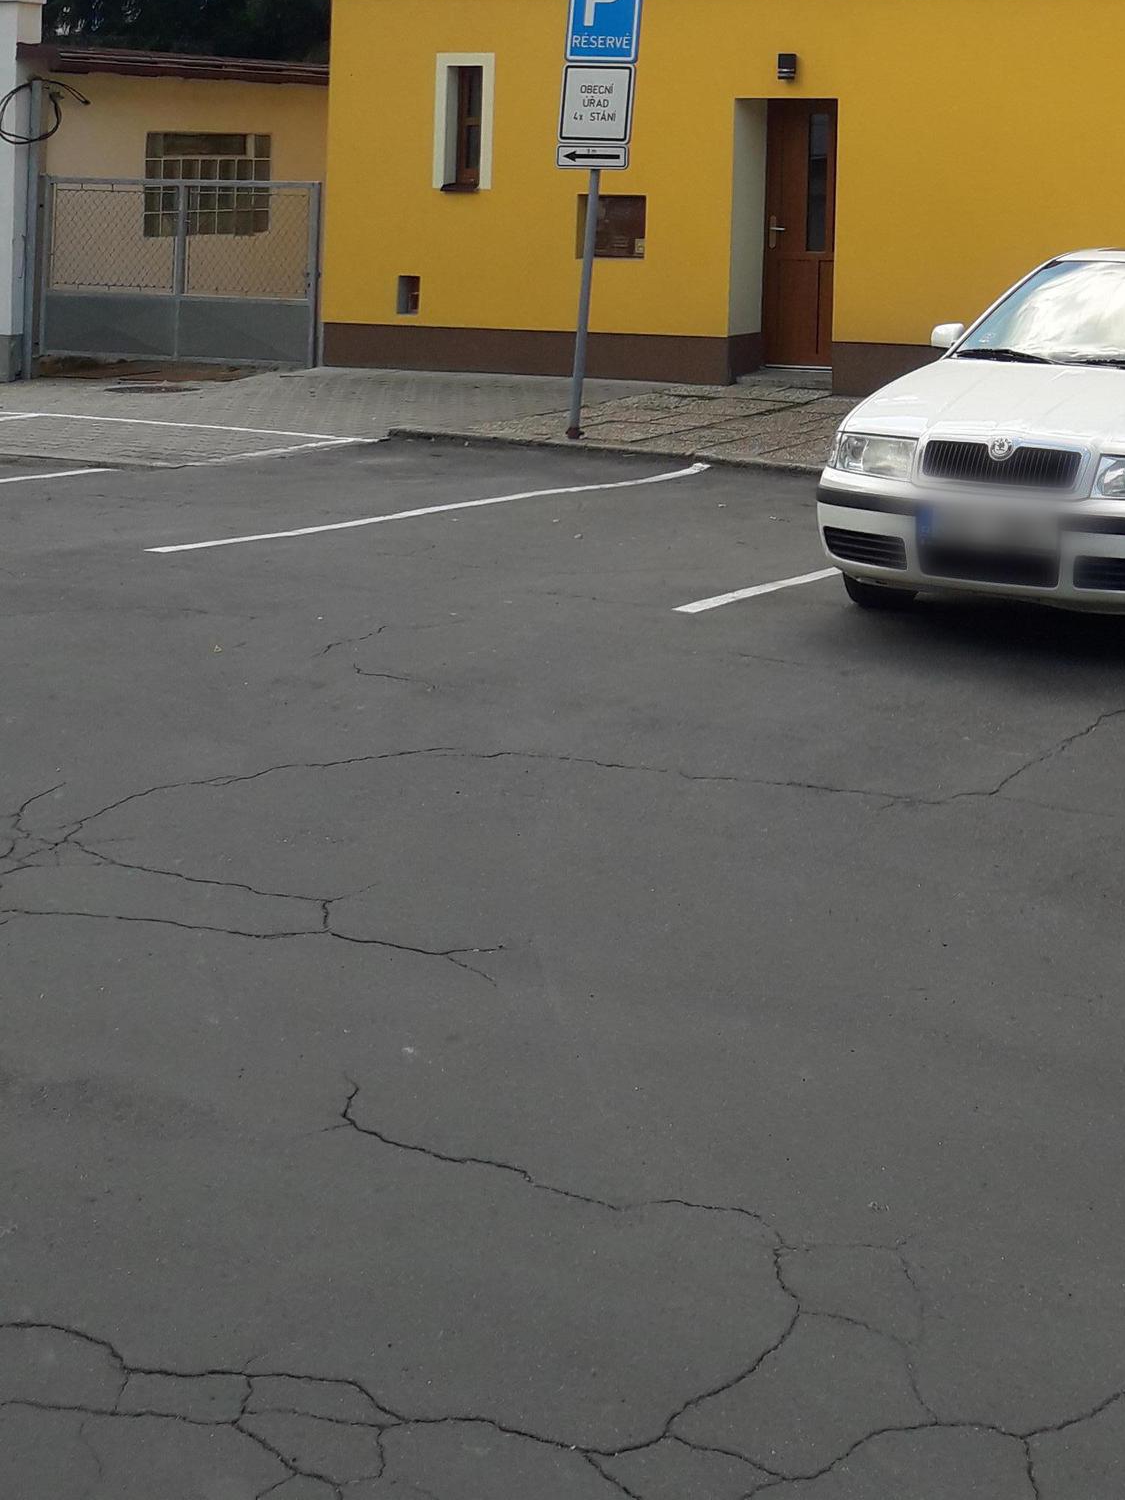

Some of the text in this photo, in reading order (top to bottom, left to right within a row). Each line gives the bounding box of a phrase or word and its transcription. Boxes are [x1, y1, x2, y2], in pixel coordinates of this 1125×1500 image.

[572, 32, 632, 48] RÉSERVÉ
[580, 83, 614, 94] OBECNÍ
[582, 95, 609, 108] ÚŘAD
[589, 110, 616, 122] STÁNÍ
